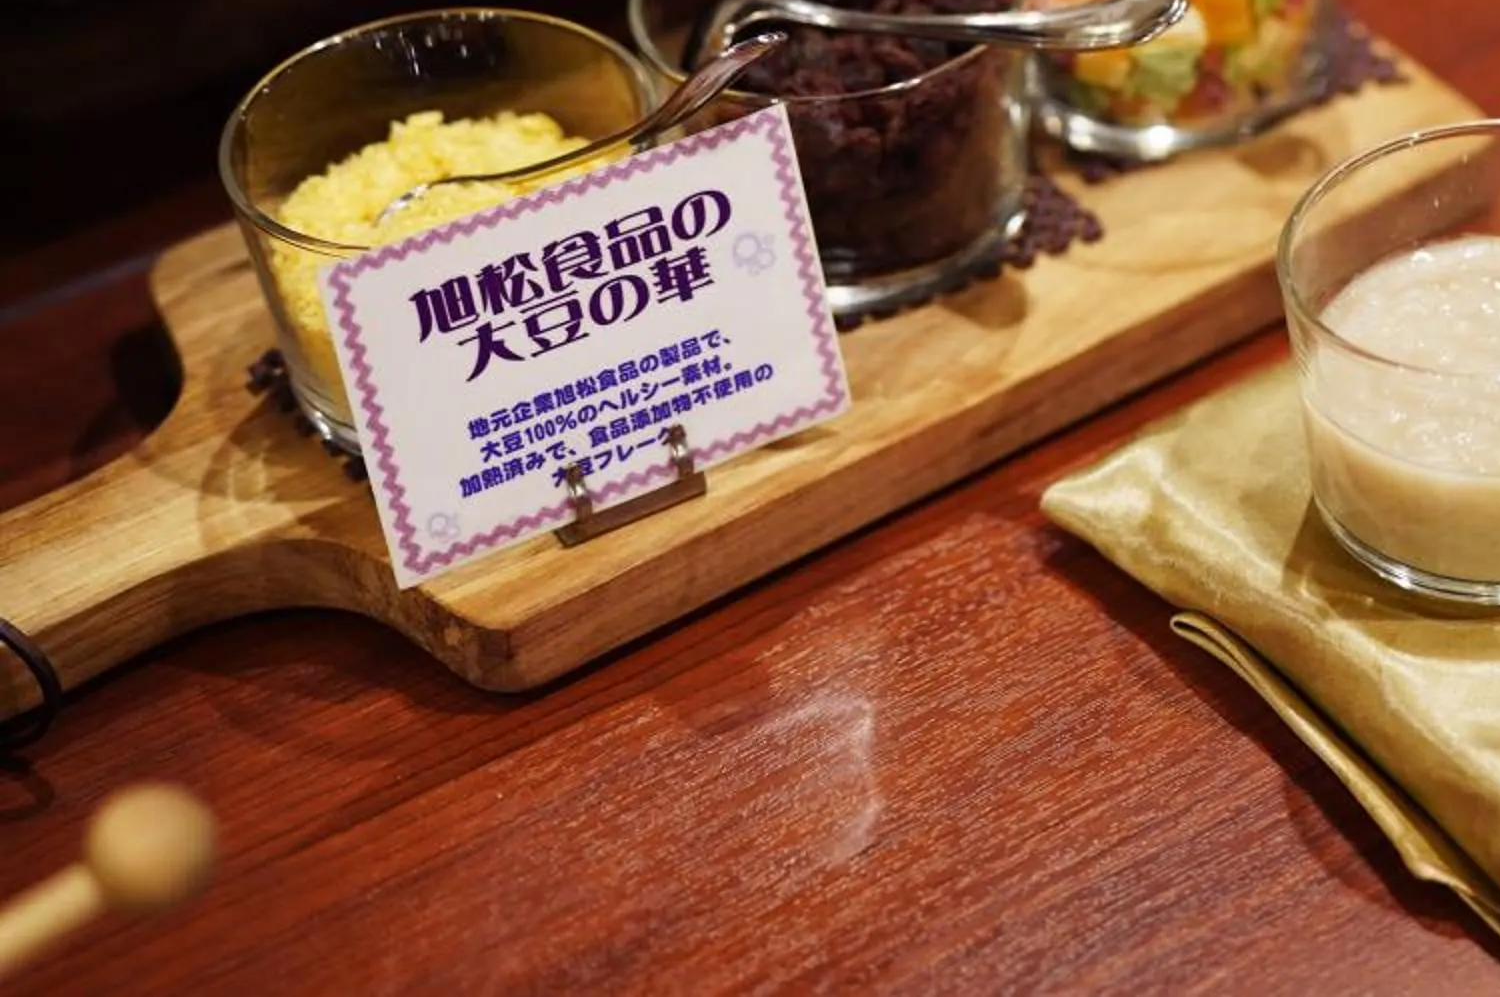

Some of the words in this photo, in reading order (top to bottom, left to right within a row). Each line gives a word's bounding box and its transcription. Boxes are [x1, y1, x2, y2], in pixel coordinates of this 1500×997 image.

[409, 189, 731, 345] 旭松食品の
[456, 246, 716, 382] 大豆の華
[459, 363, 775, 498] 加熱済みで、食品添加物不使用の
[467, 329, 733, 440] 地元企業旭松食品の製品で、
